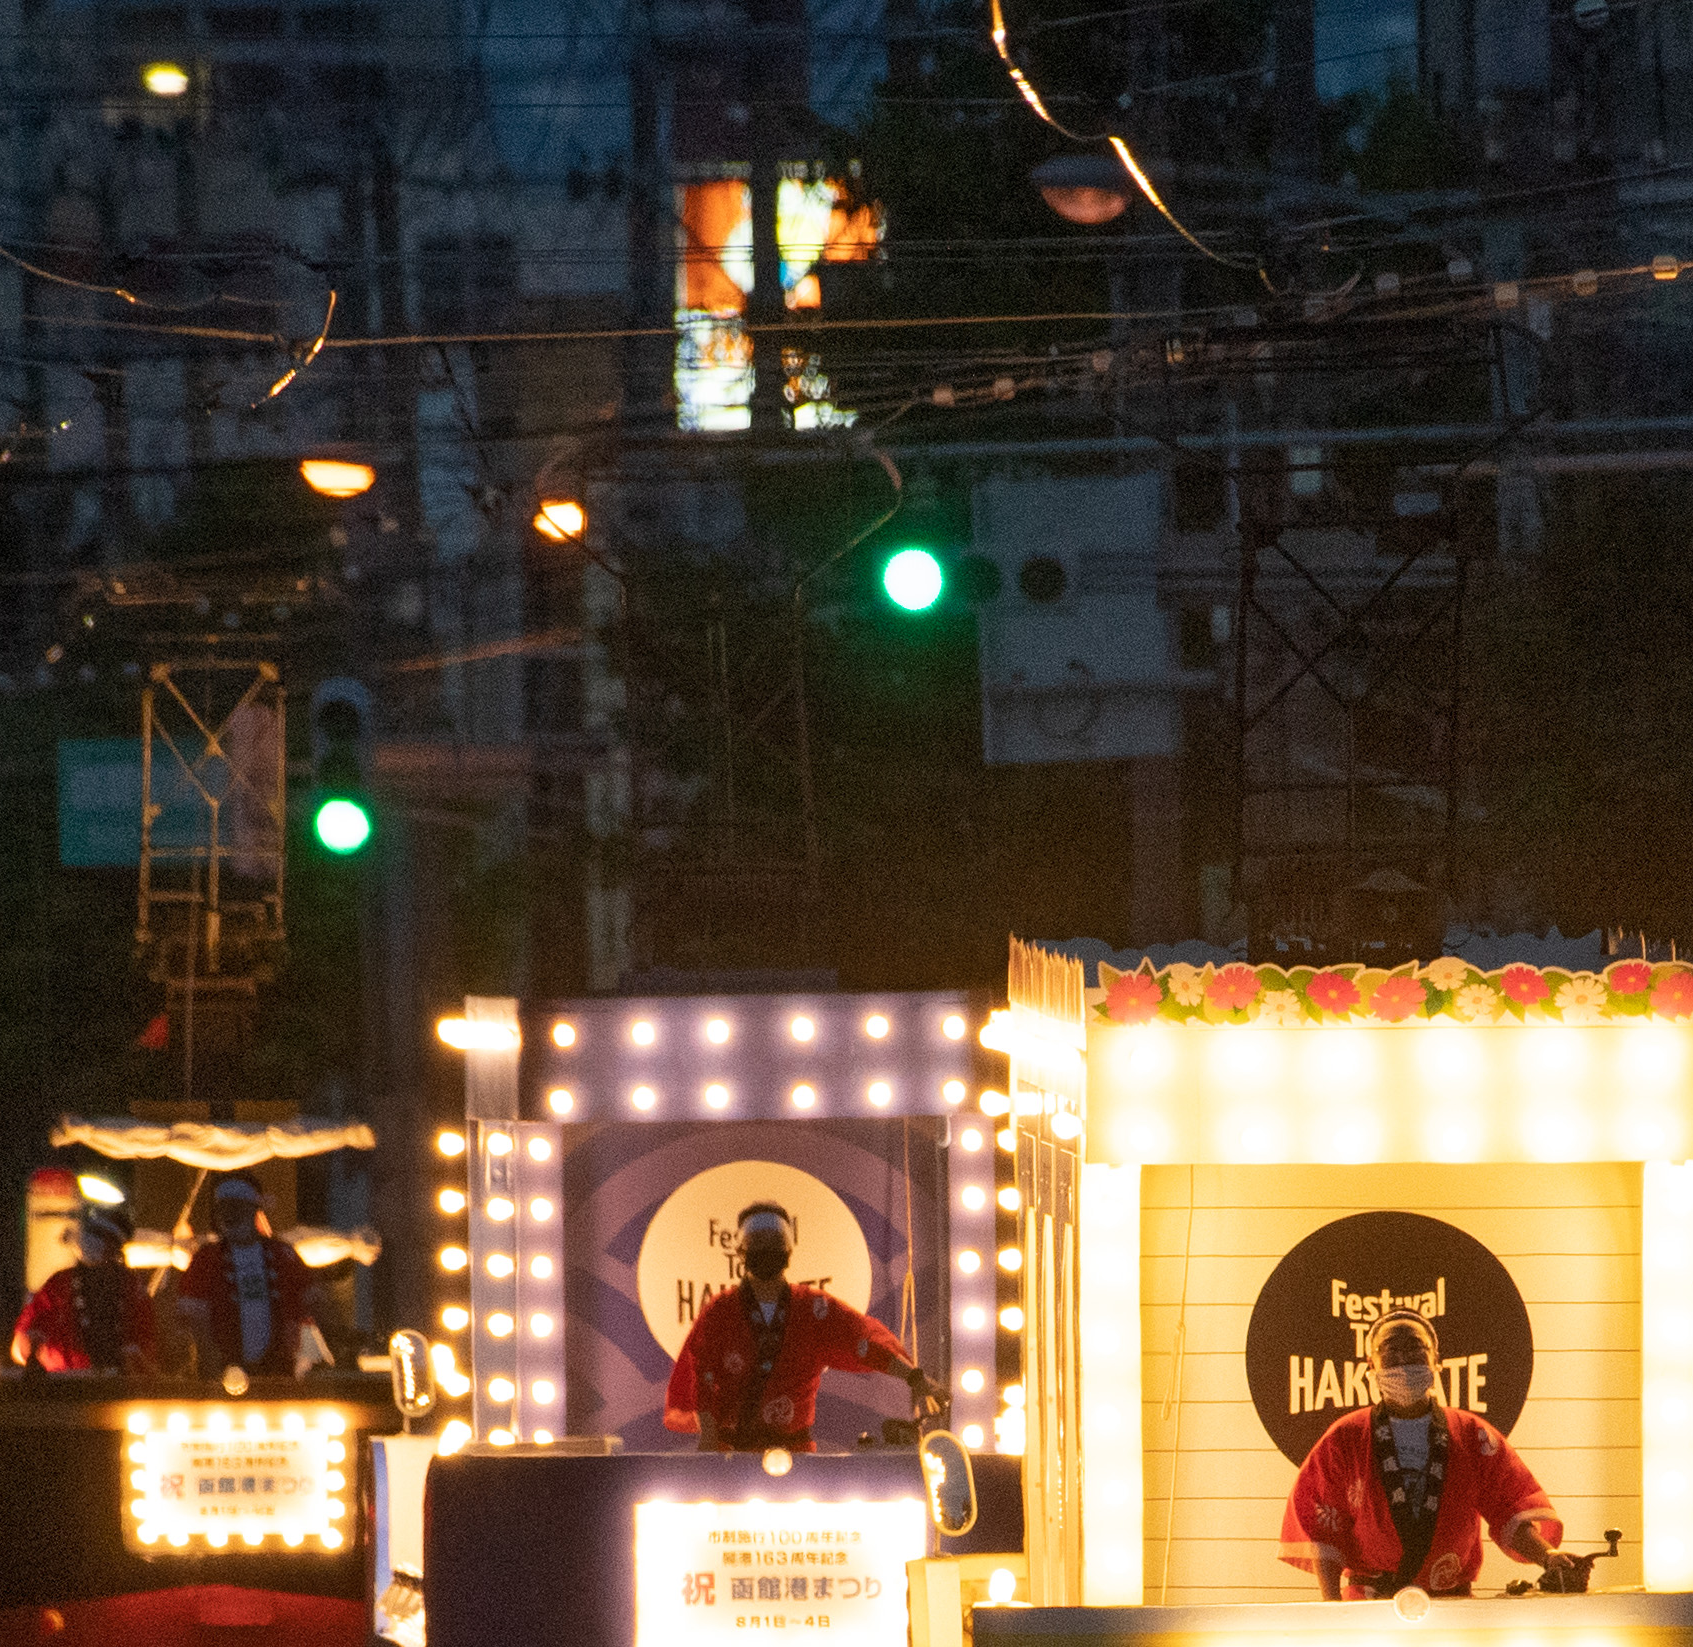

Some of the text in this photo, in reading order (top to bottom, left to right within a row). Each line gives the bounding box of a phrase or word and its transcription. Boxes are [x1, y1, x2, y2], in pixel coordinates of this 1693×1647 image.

[1289, 1353, 1488, 1415] HAKATE
[681, 1571, 883, 1605] 祝 函館港まつり
